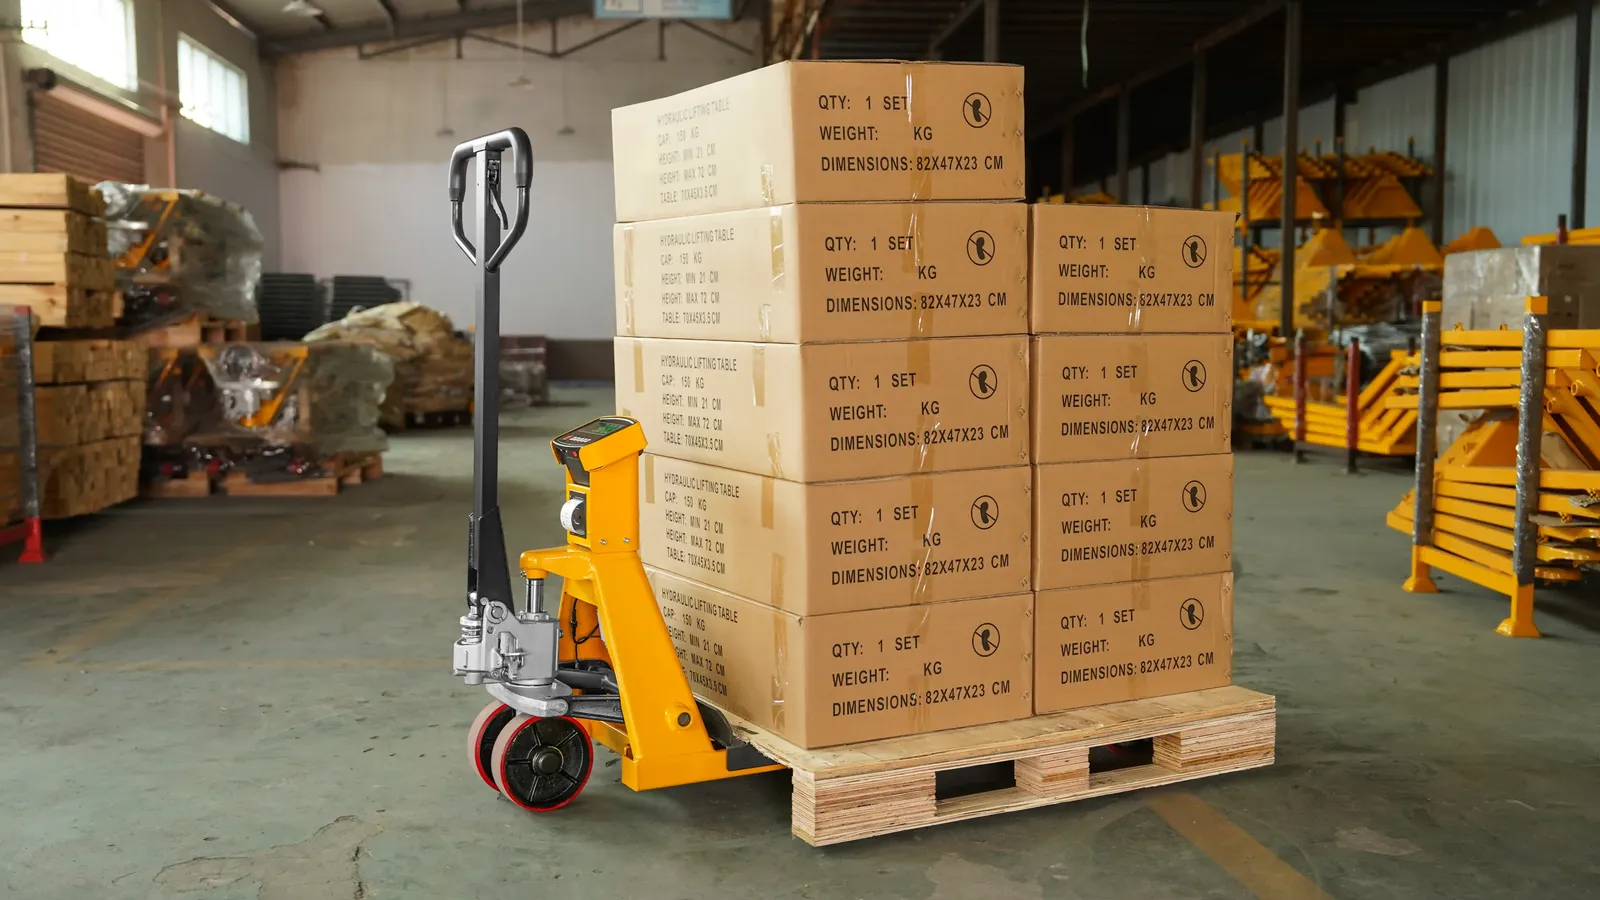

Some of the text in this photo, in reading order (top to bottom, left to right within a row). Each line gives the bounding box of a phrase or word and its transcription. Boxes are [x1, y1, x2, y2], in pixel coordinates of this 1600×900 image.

[818, 94, 908, 110] QTY: 1 SET
[820, 126, 932, 140] WEIGHT: KG
[822, 156, 1002, 172] DIMENSIONS: 82X47X23 CM
[660, 228, 734, 246] HYDRAULIC LIFTING TABLE
[824, 236, 914, 252] QTY: 1 SET
[1060, 234, 1136, 250] QTY: 1 SET
[661, 254, 673, 265] CAP:
[694, 252, 702, 263] KG
[661, 271, 718, 284] HEIGHT: MIN 21 CM
[826, 266, 936, 282] WEIGHT: KG
[1058, 264, 1154, 278] WEIGHT: KG
[662, 292, 719, 304] HEIGHT: MAX 72 CM
[826, 292, 1006, 312] DIMENSIONS: 82X47X23 CM
[1058, 292, 1136, 306] DIMENSIONS:
[1198, 294, 1214, 306] CM
[662, 312, 680, 323] TABLE:
[661, 355, 736, 371] HYDRAULIC LIFTING TABLE
[662, 375, 704, 389] CAP: 150 KG
[830, 372, 916, 392] QTY: 1 SET
[1062, 366, 1138, 380] QTY: 1 SET
[663, 394, 721, 410] HEIGHT: MIN 21 CM
[1062, 392, 1156, 408] WEIGHT: KG
[830, 400, 940, 420] WEIGHT: KG
[663, 413, 722, 431] HEIGHT: MAX 72 CM
[1062, 416, 1214, 436] DIMENSIONS: 82X47X23 CM
[664, 431, 682, 445] TABLE:
[830, 424, 1008, 452] DIMENSIONS: 82X47X23 CM
[664, 472, 739, 498] HYDRAULIC LIFTING TABLE
[665, 491, 706, 510] CAP: 150 KG
[1062, 488, 1138, 506] QTY: 1 SET
[666, 510, 723, 534] HEIGHT: MIN 21 CM
[830, 506, 918, 526] QTY: 1 SET
[1062, 514, 1156, 534] WEIGHT: KG
[666, 528, 724, 554] HEIGHT: MAX 72 CM
[830, 532, 940, 556] WEIGHT: KG
[1062, 536, 1214, 562] DIMENSIONS: 82X47X23 CM
[667, 547, 685, 562] TABLE:
[832, 554, 1008, 586] DIMENSIONS: 82X47X23 CM
[662, 588, 738, 623] HYDRAULIC LIFTING TABLE
[663, 606, 705, 631] CAP: 150 KG
[1060, 608, 1134, 630] QTY: 1 SET
[668, 626, 723, 656] EIGHT: MIN 21 CM
[832, 634, 920, 658] QTY: 1 SET
[1060, 634, 1154, 656] WEIGHT: KG
[691, 653, 703, 668] MAX
[706, 659, 712, 671] 72
[716, 663, 725, 677] CM
[1060, 652, 1214, 684] DIMENSIONS: 82X47X23 CM
[832, 662, 942, 688] WEIGHT: KG
[832, 680, 1010, 716] DIMENSIONS: 82X47X23 CM
